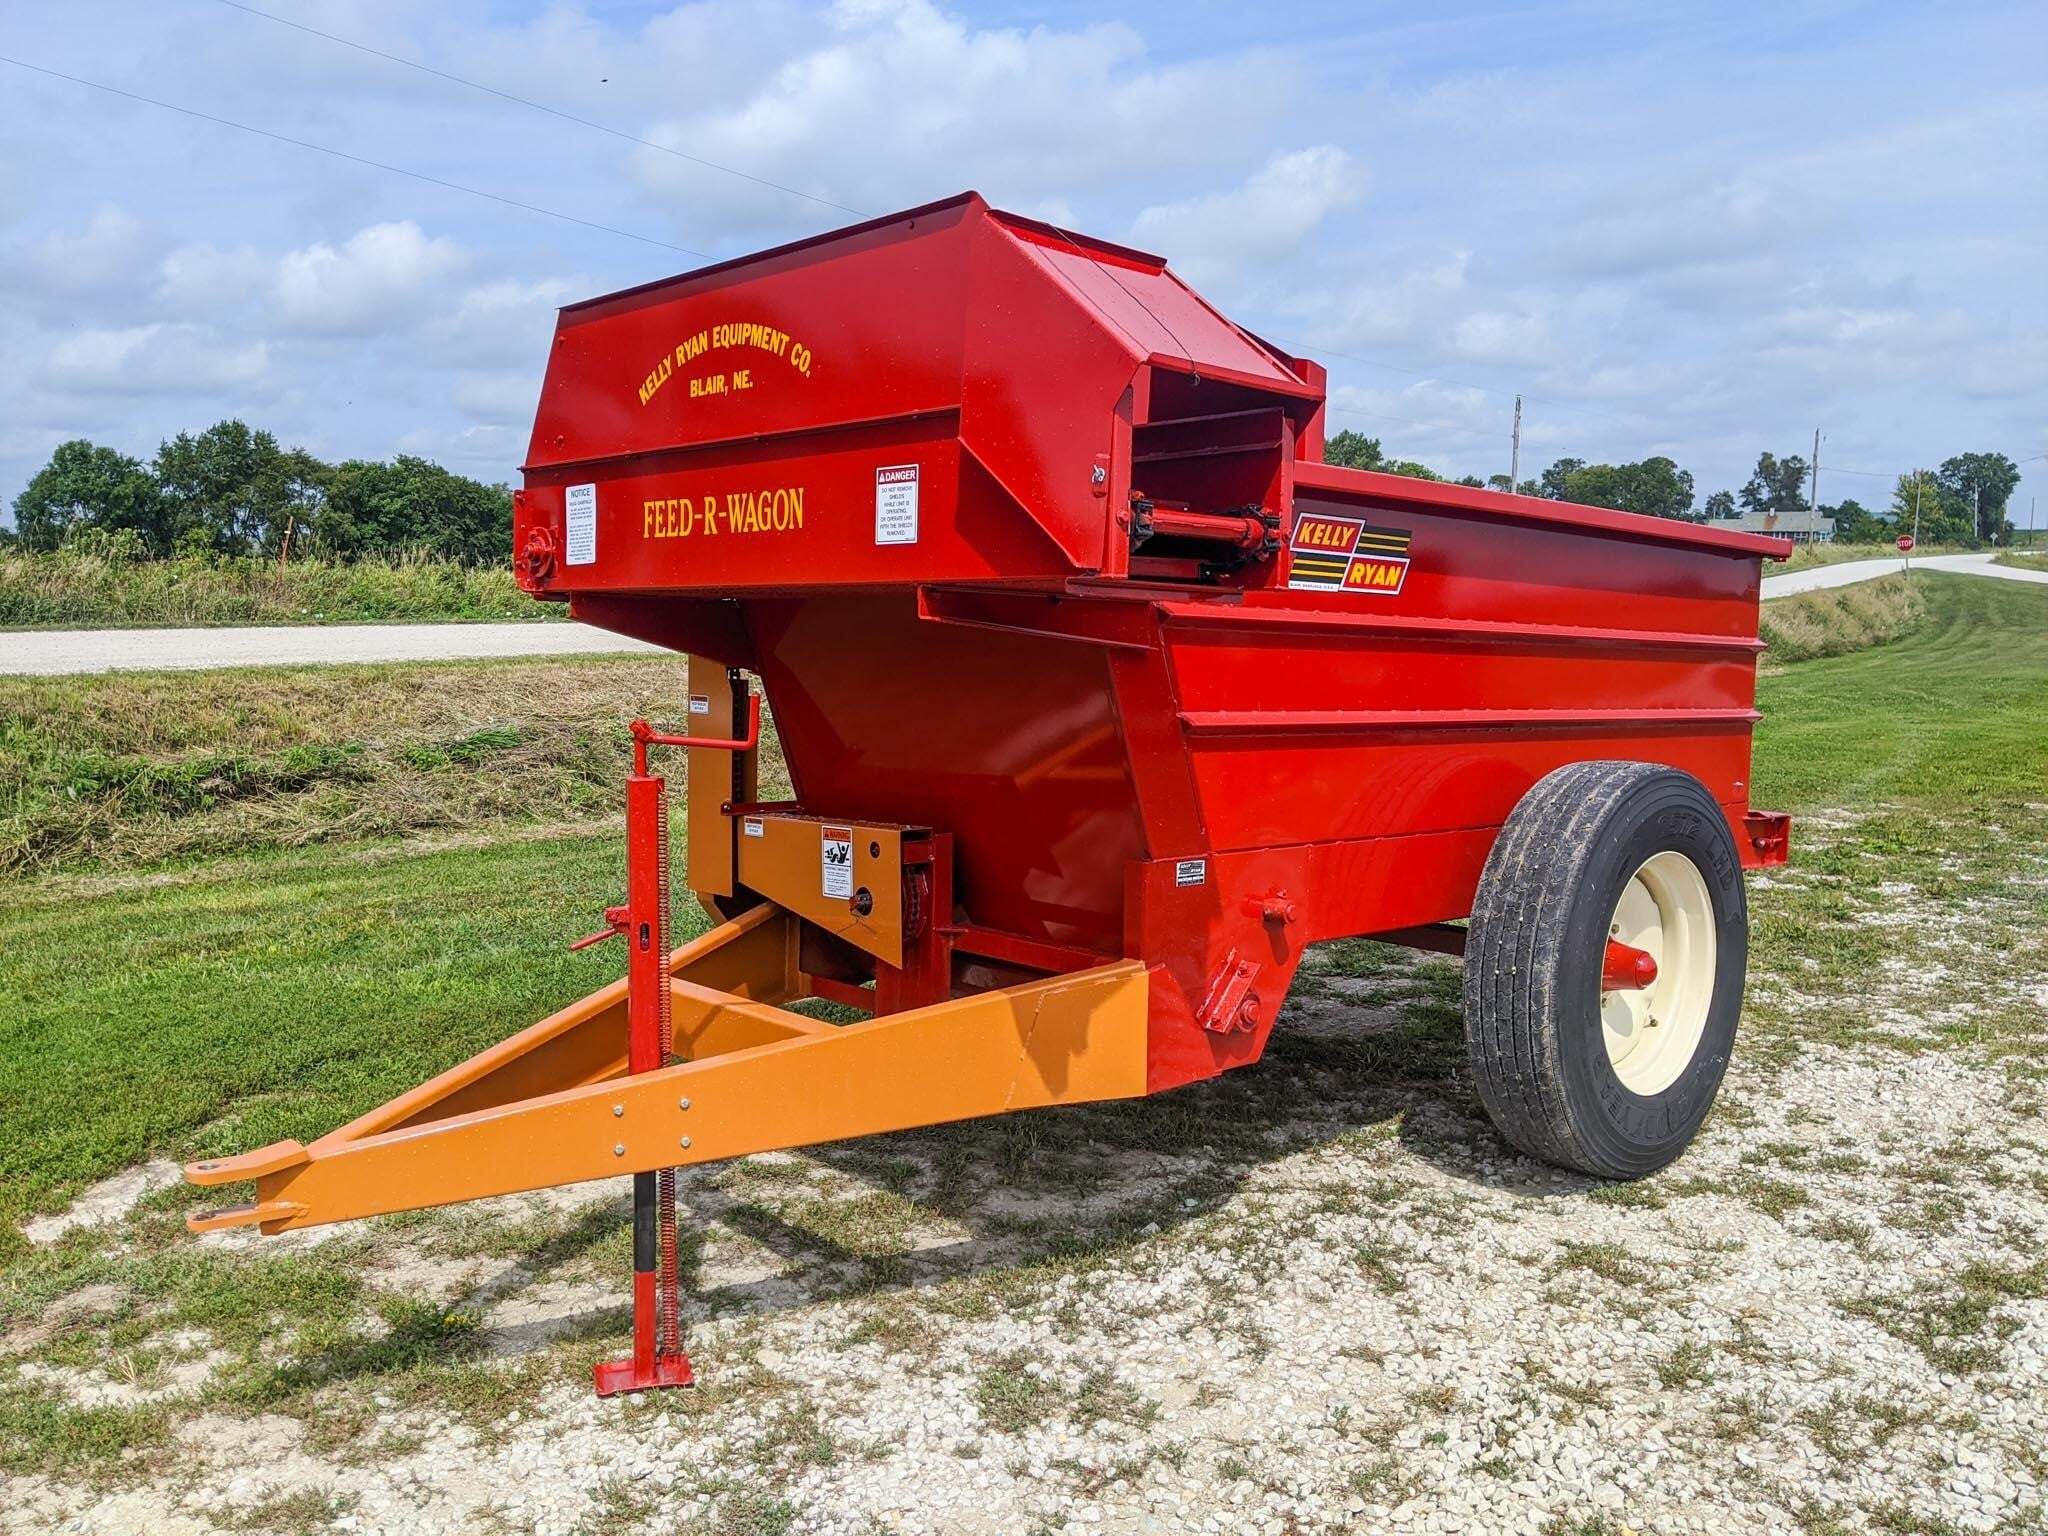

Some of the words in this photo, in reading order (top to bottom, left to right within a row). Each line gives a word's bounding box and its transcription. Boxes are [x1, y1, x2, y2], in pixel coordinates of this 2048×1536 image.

[638, 354, 672, 406] KELLY
[676, 330, 708, 367] RYAN
[713, 323, 790, 357] EQUIPMENT
[790, 342, 812, 378] CO.
[690, 374, 729, 398] BLAIR,
[733, 369, 754, 390] NE.
[886, 470, 916, 481] DANGER
[570, 488, 591, 498] NOTICE
[643, 487, 804, 539] FEED-R-WAGON
[1298, 522, 1356, 547] KELLY
[1348, 562, 1401, 587] RYAN
